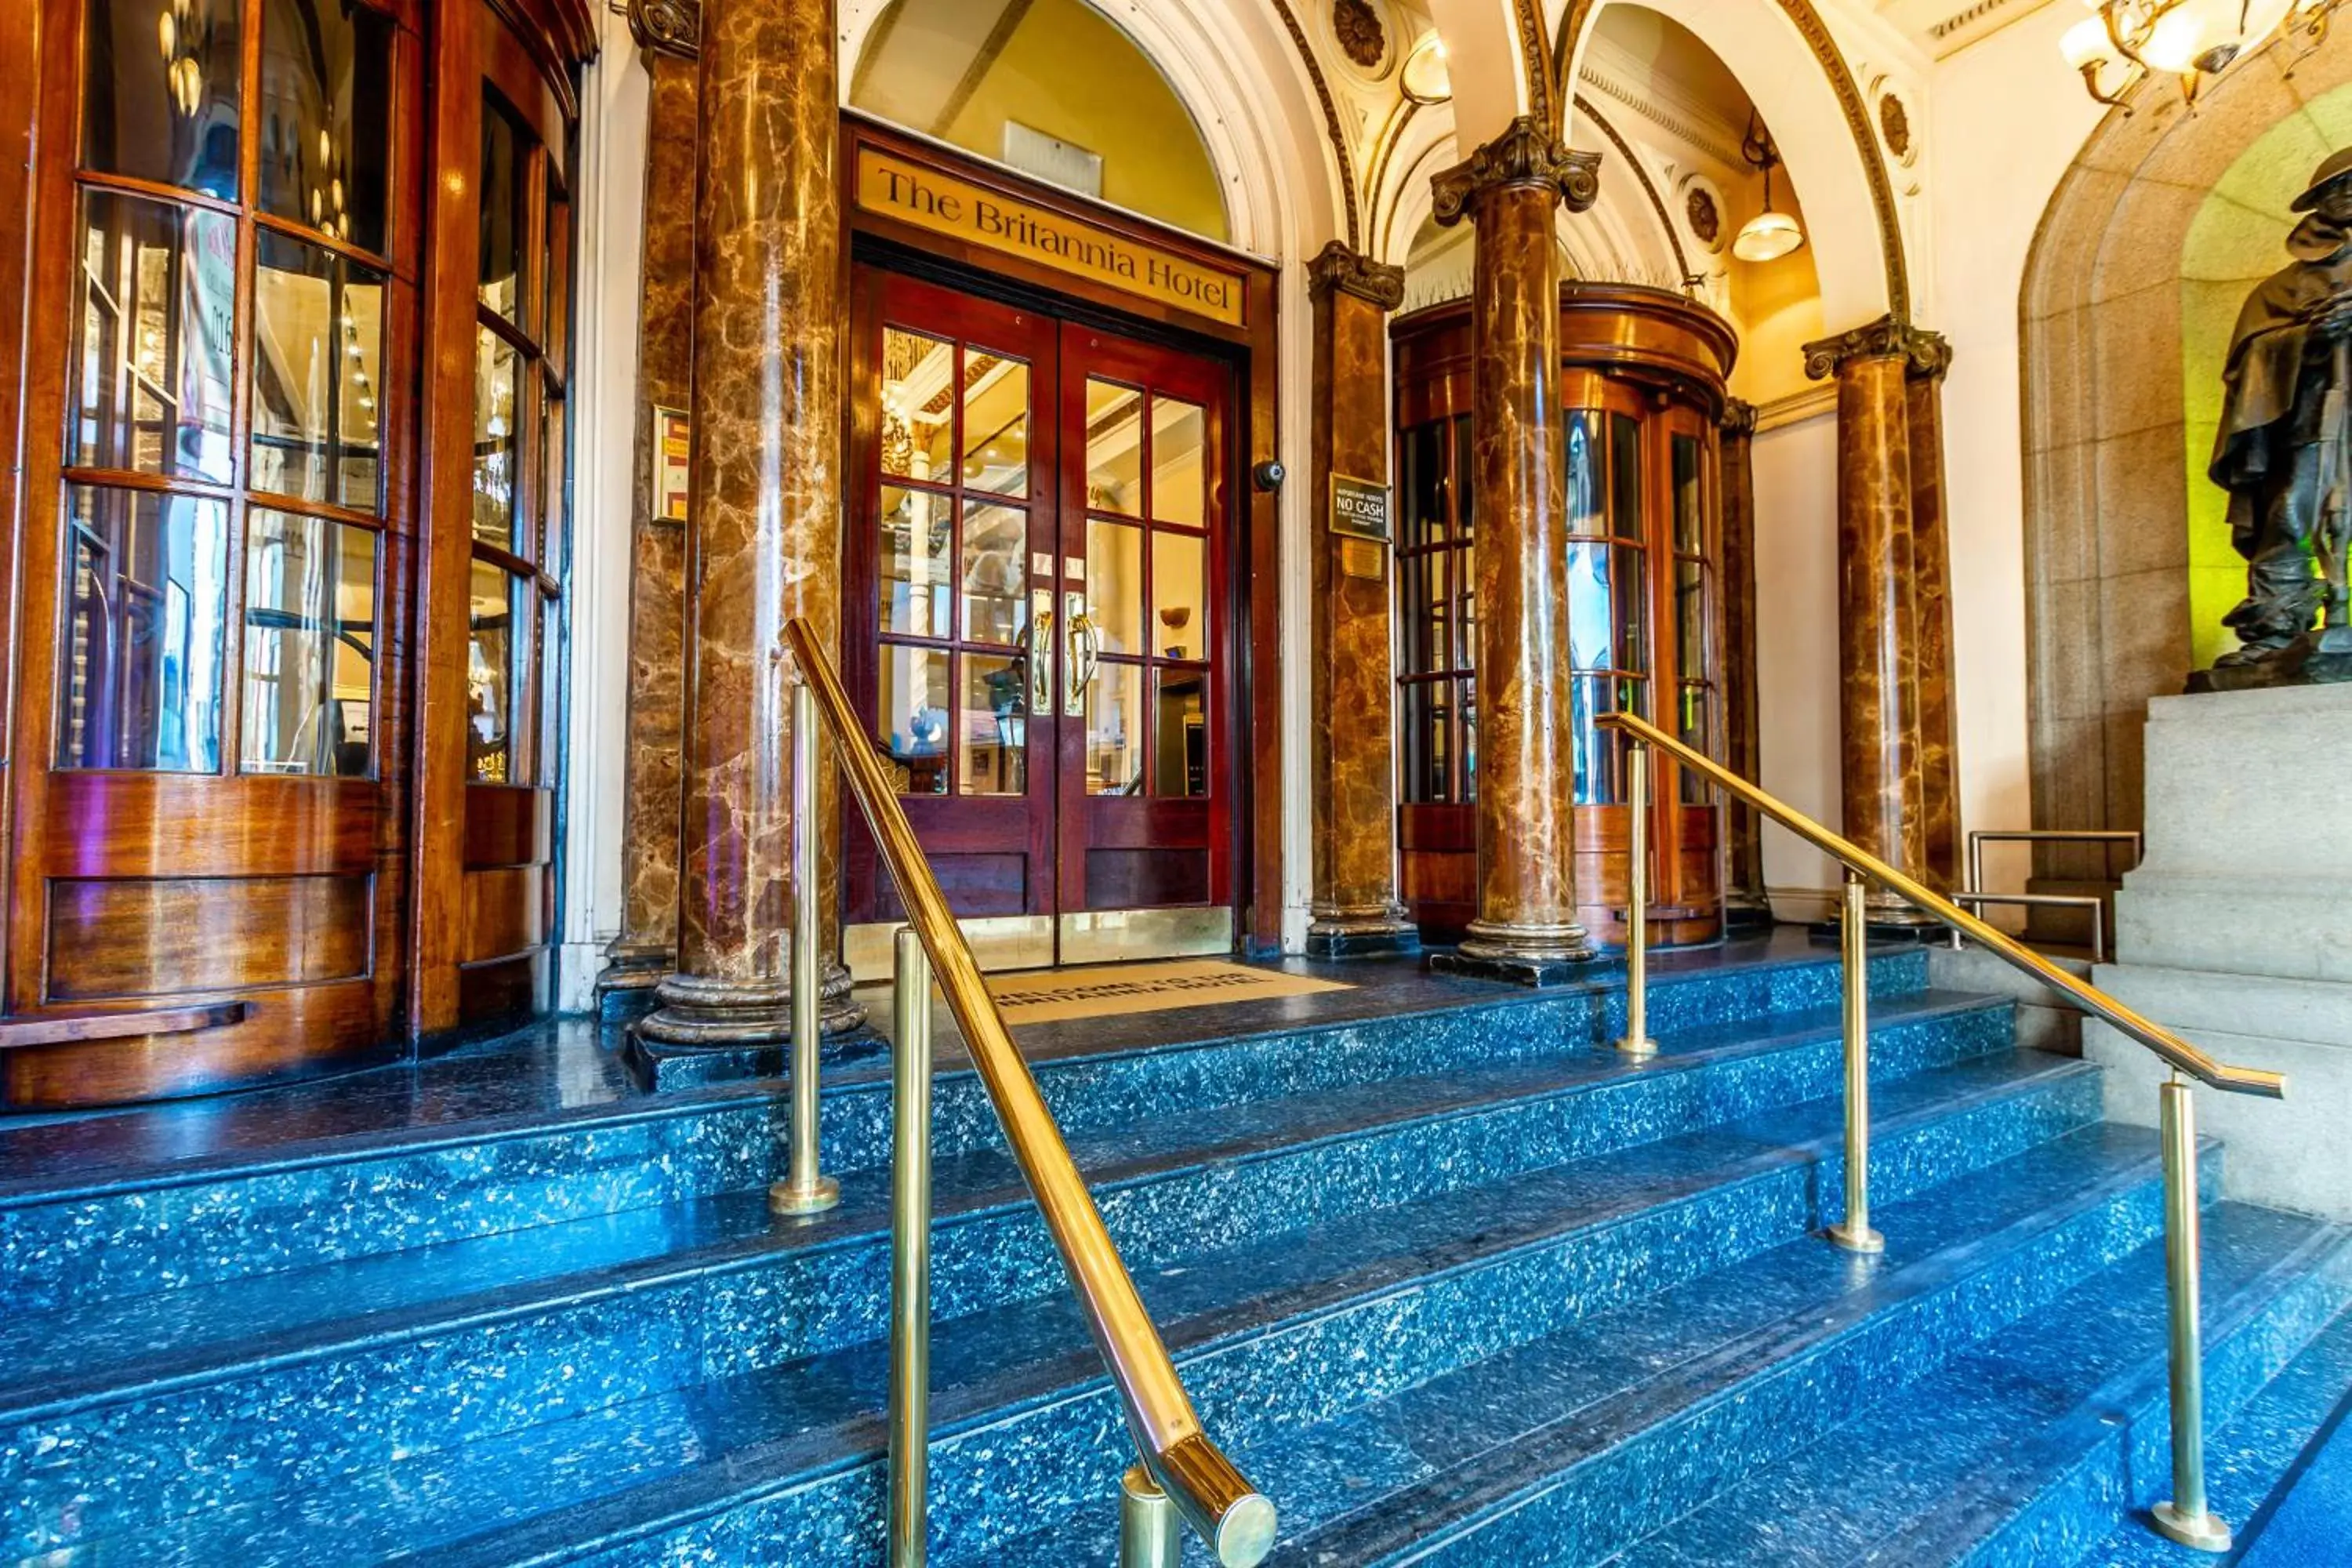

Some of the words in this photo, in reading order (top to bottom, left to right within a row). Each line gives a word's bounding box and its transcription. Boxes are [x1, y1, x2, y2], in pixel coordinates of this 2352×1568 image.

[878, 168, 963, 223] The
[975, 200, 1136, 280] Britannia
[1147, 257, 1229, 309] Hotel
[1337, 496, 1353, 510] NO
[1356, 501, 1385, 517] CASH
